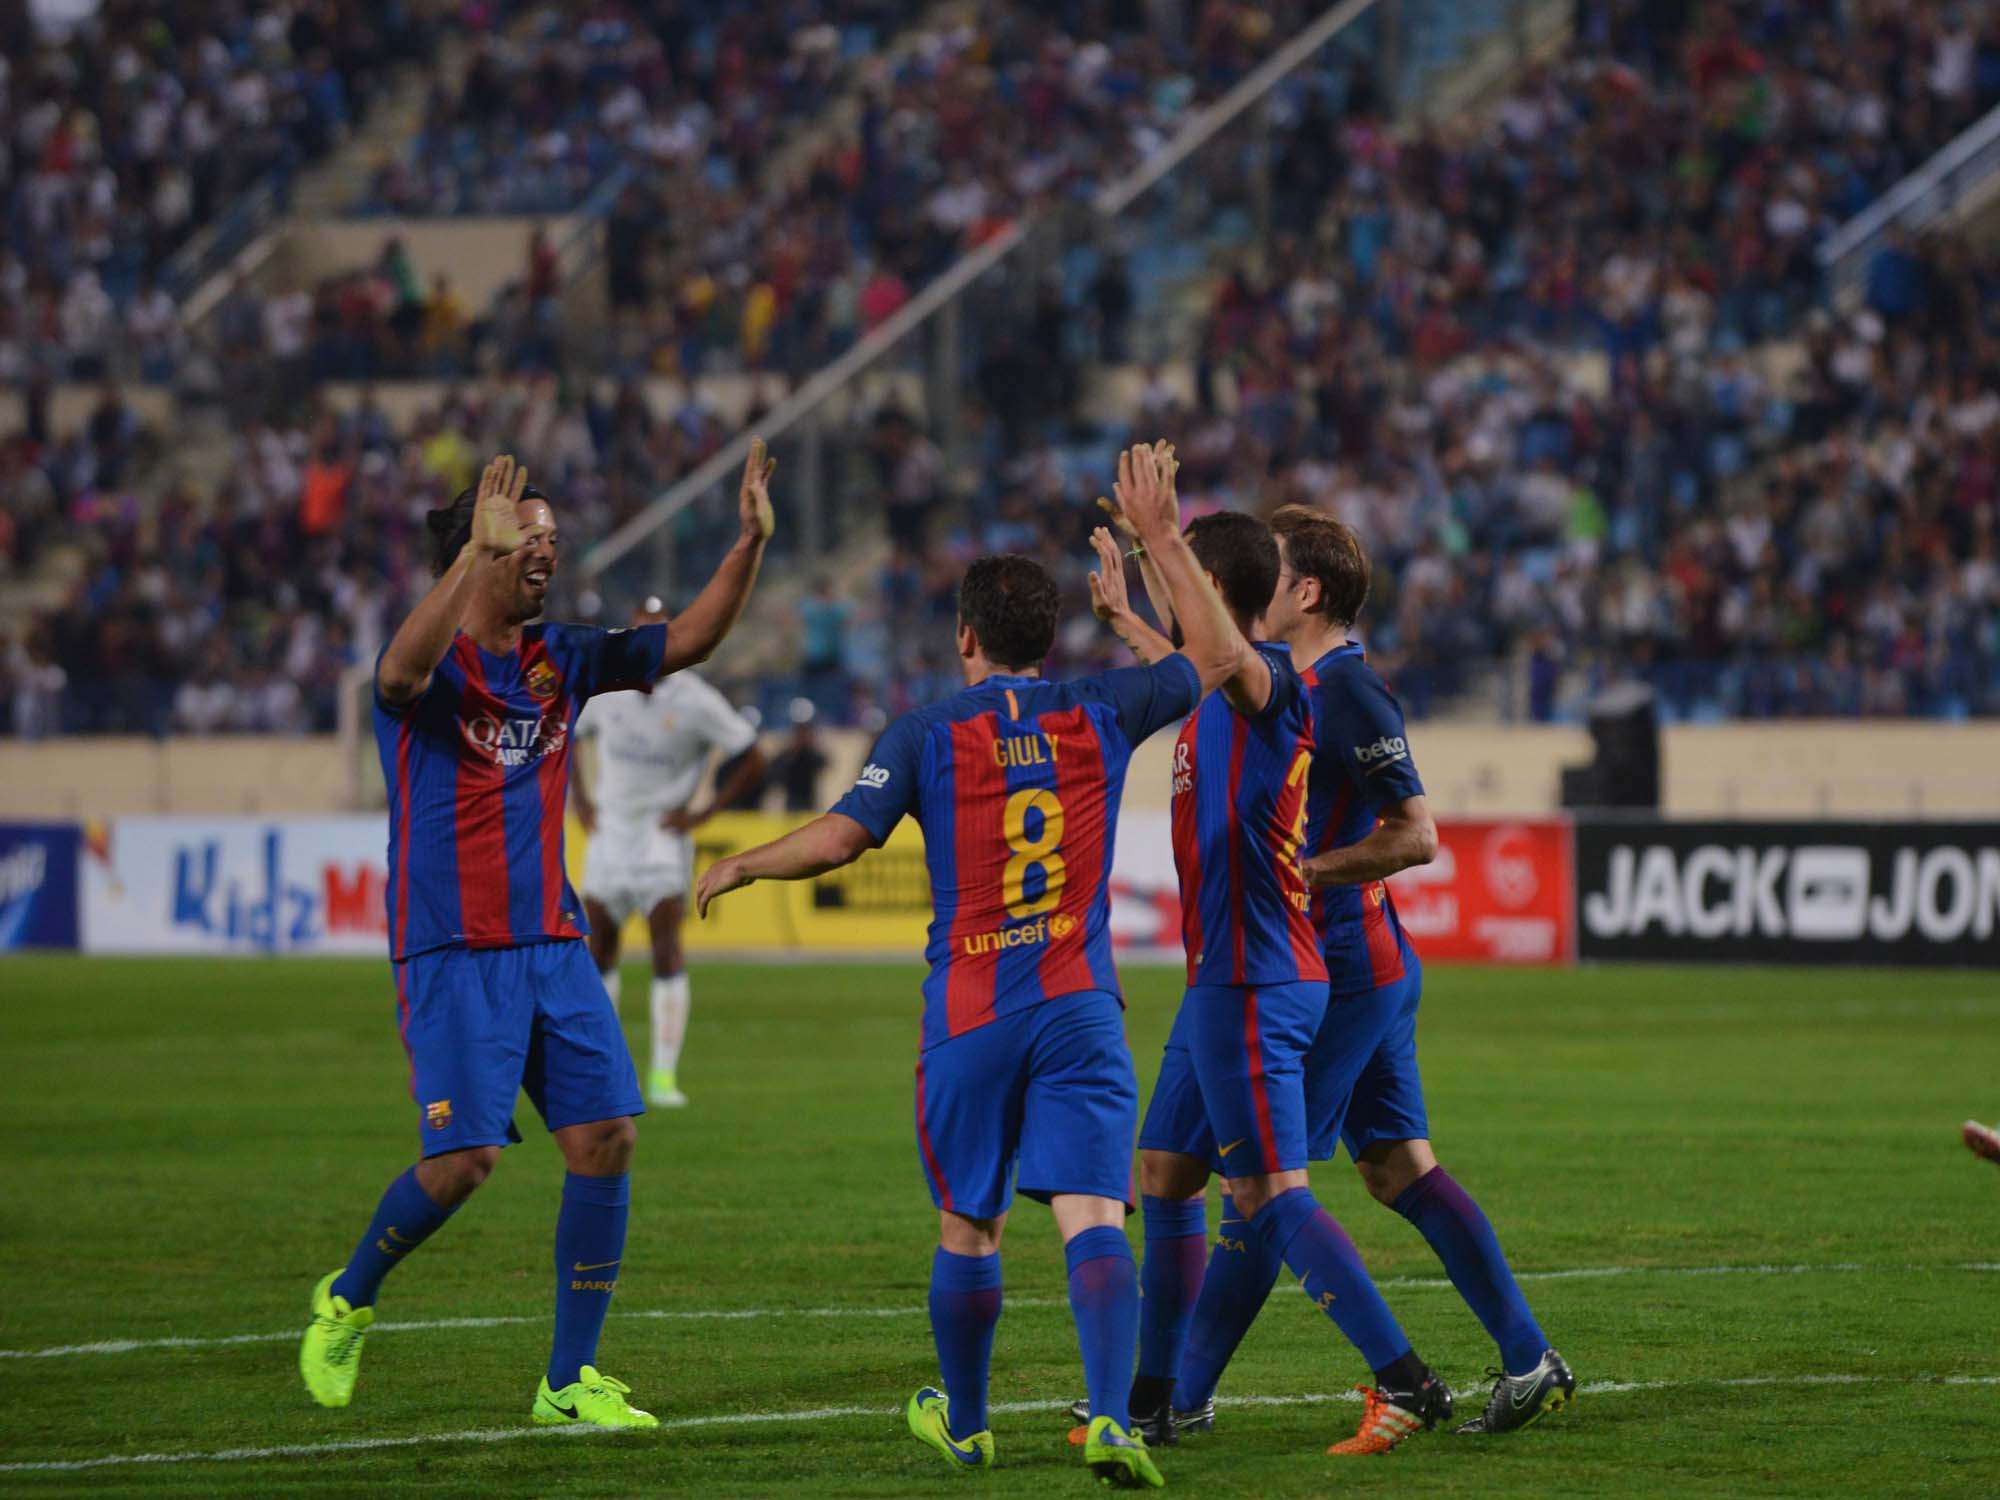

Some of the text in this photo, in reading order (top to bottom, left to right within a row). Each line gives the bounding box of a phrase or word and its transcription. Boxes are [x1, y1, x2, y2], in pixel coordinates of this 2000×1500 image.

[993, 733, 1059, 768] GIULY
[1354, 736, 1405, 763] beko
[861, 763, 890, 784] ko
[1003, 788, 1066, 919] 8
[1585, 845, 1788, 939] JACK
[964, 917, 1047, 955] unicef
